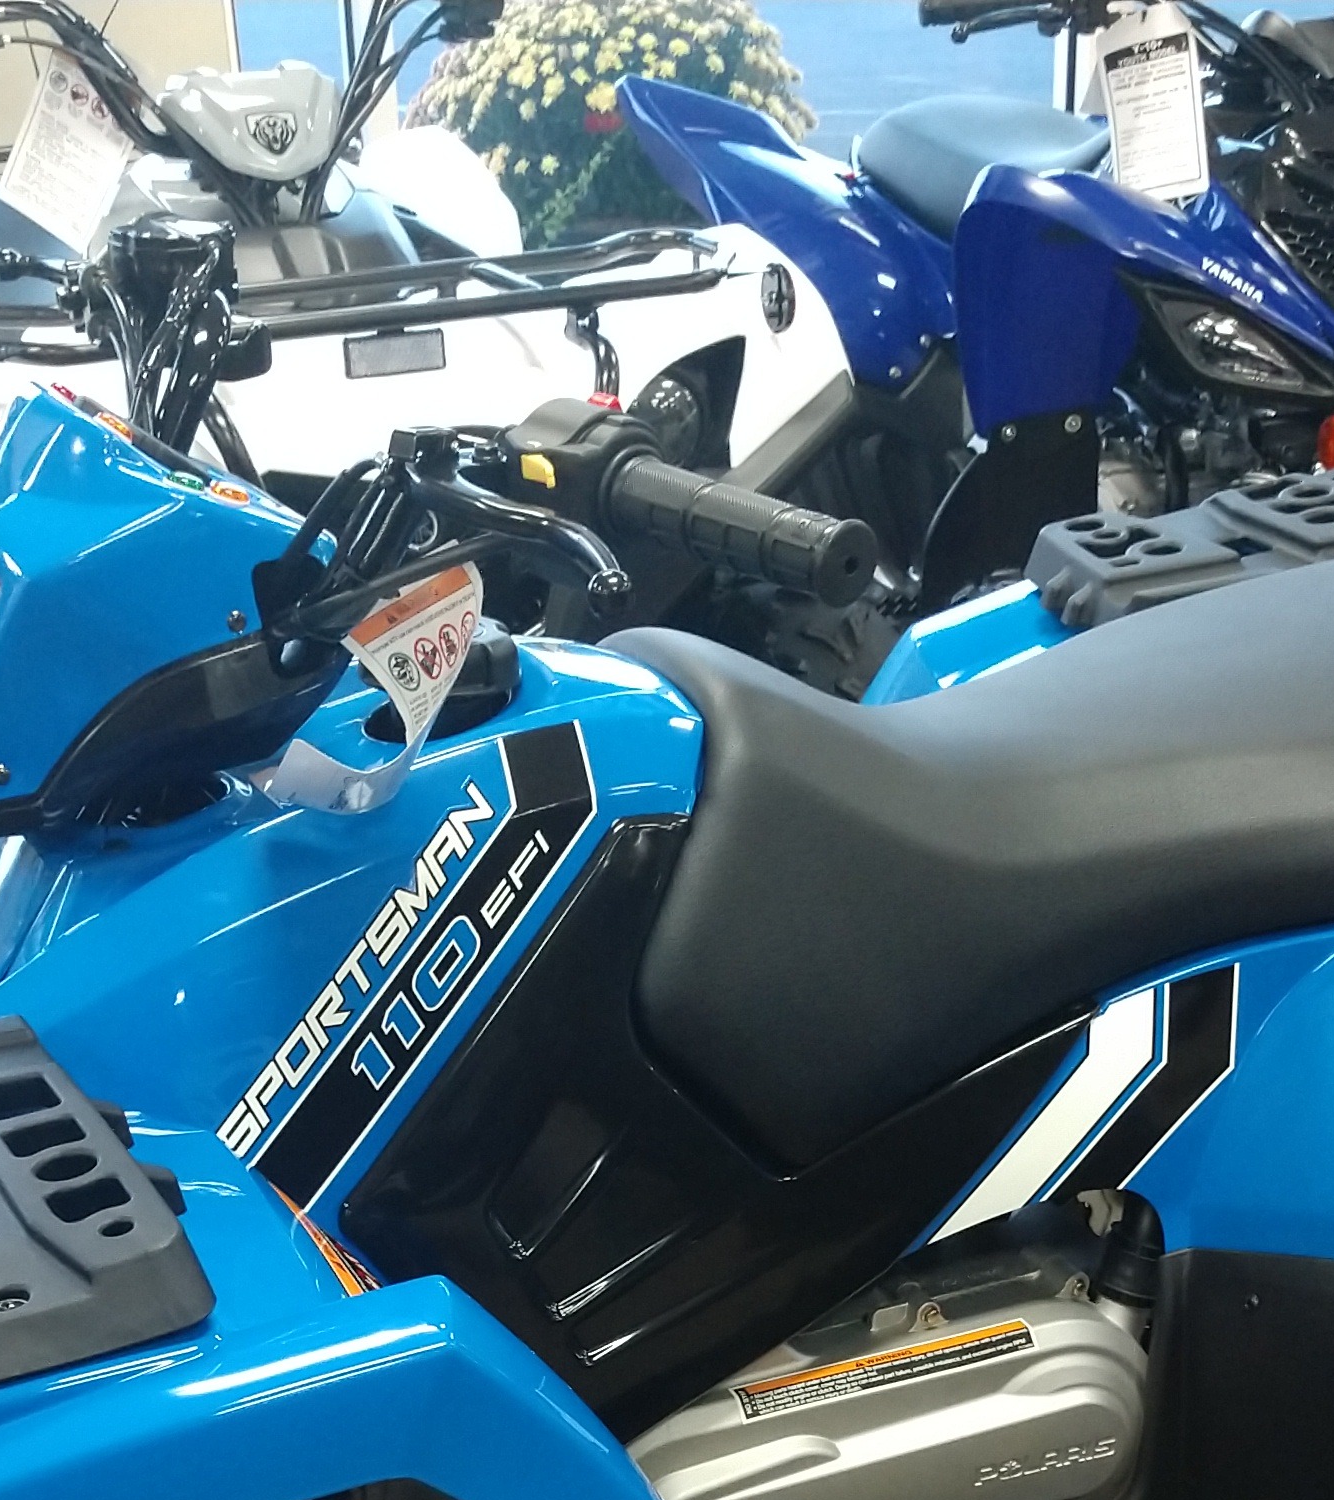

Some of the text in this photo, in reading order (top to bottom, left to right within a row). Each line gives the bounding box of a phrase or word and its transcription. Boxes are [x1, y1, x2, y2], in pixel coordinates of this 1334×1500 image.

[1201, 256, 1264, 303] YAMAHA
[216, 782, 495, 1159] SPORTSMAN
[350, 829, 550, 1091] 110 EFI
[865, 1349, 912, 1364] WARNING
[974, 1438, 1117, 1487] POLARIS
